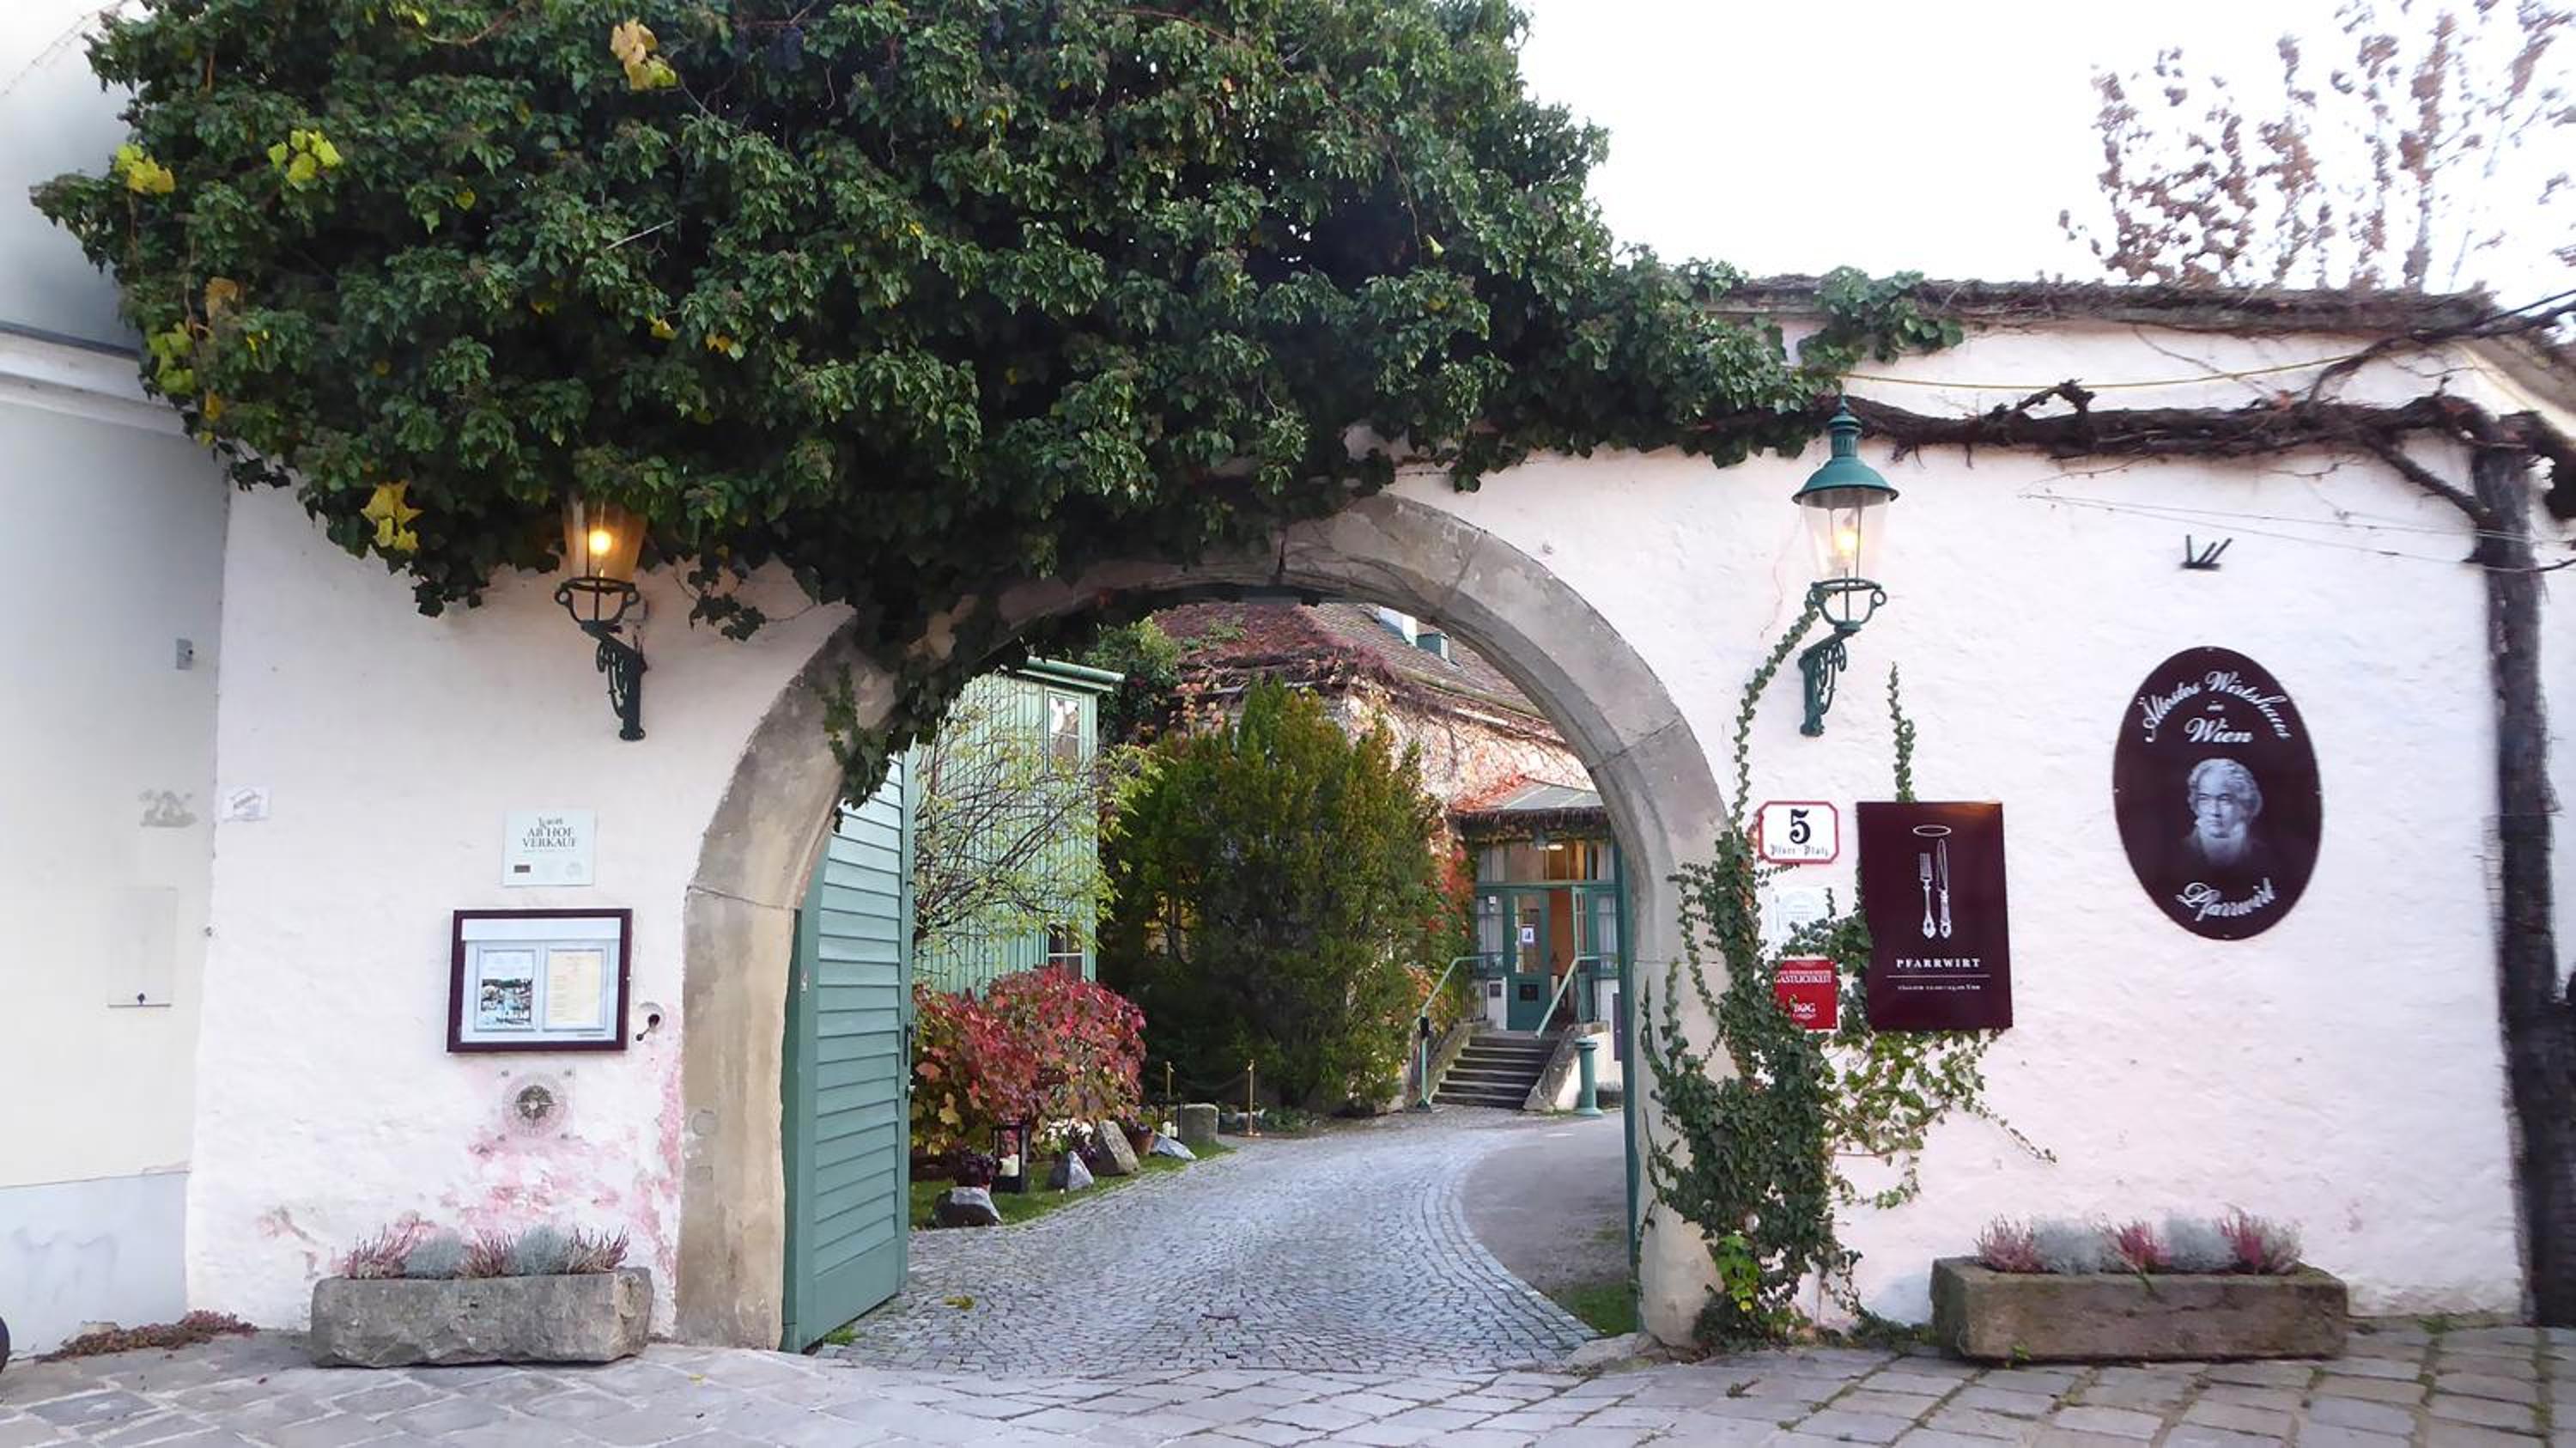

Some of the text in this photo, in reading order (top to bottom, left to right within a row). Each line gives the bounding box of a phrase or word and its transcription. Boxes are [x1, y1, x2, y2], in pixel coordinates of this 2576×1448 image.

[2184, 717, 2254, 743] Wien
[1789, 808, 1811, 844] 5
[2175, 877, 2275, 922] Pfarrwirt
[1895, 958, 1981, 969] PFARRWIRT
